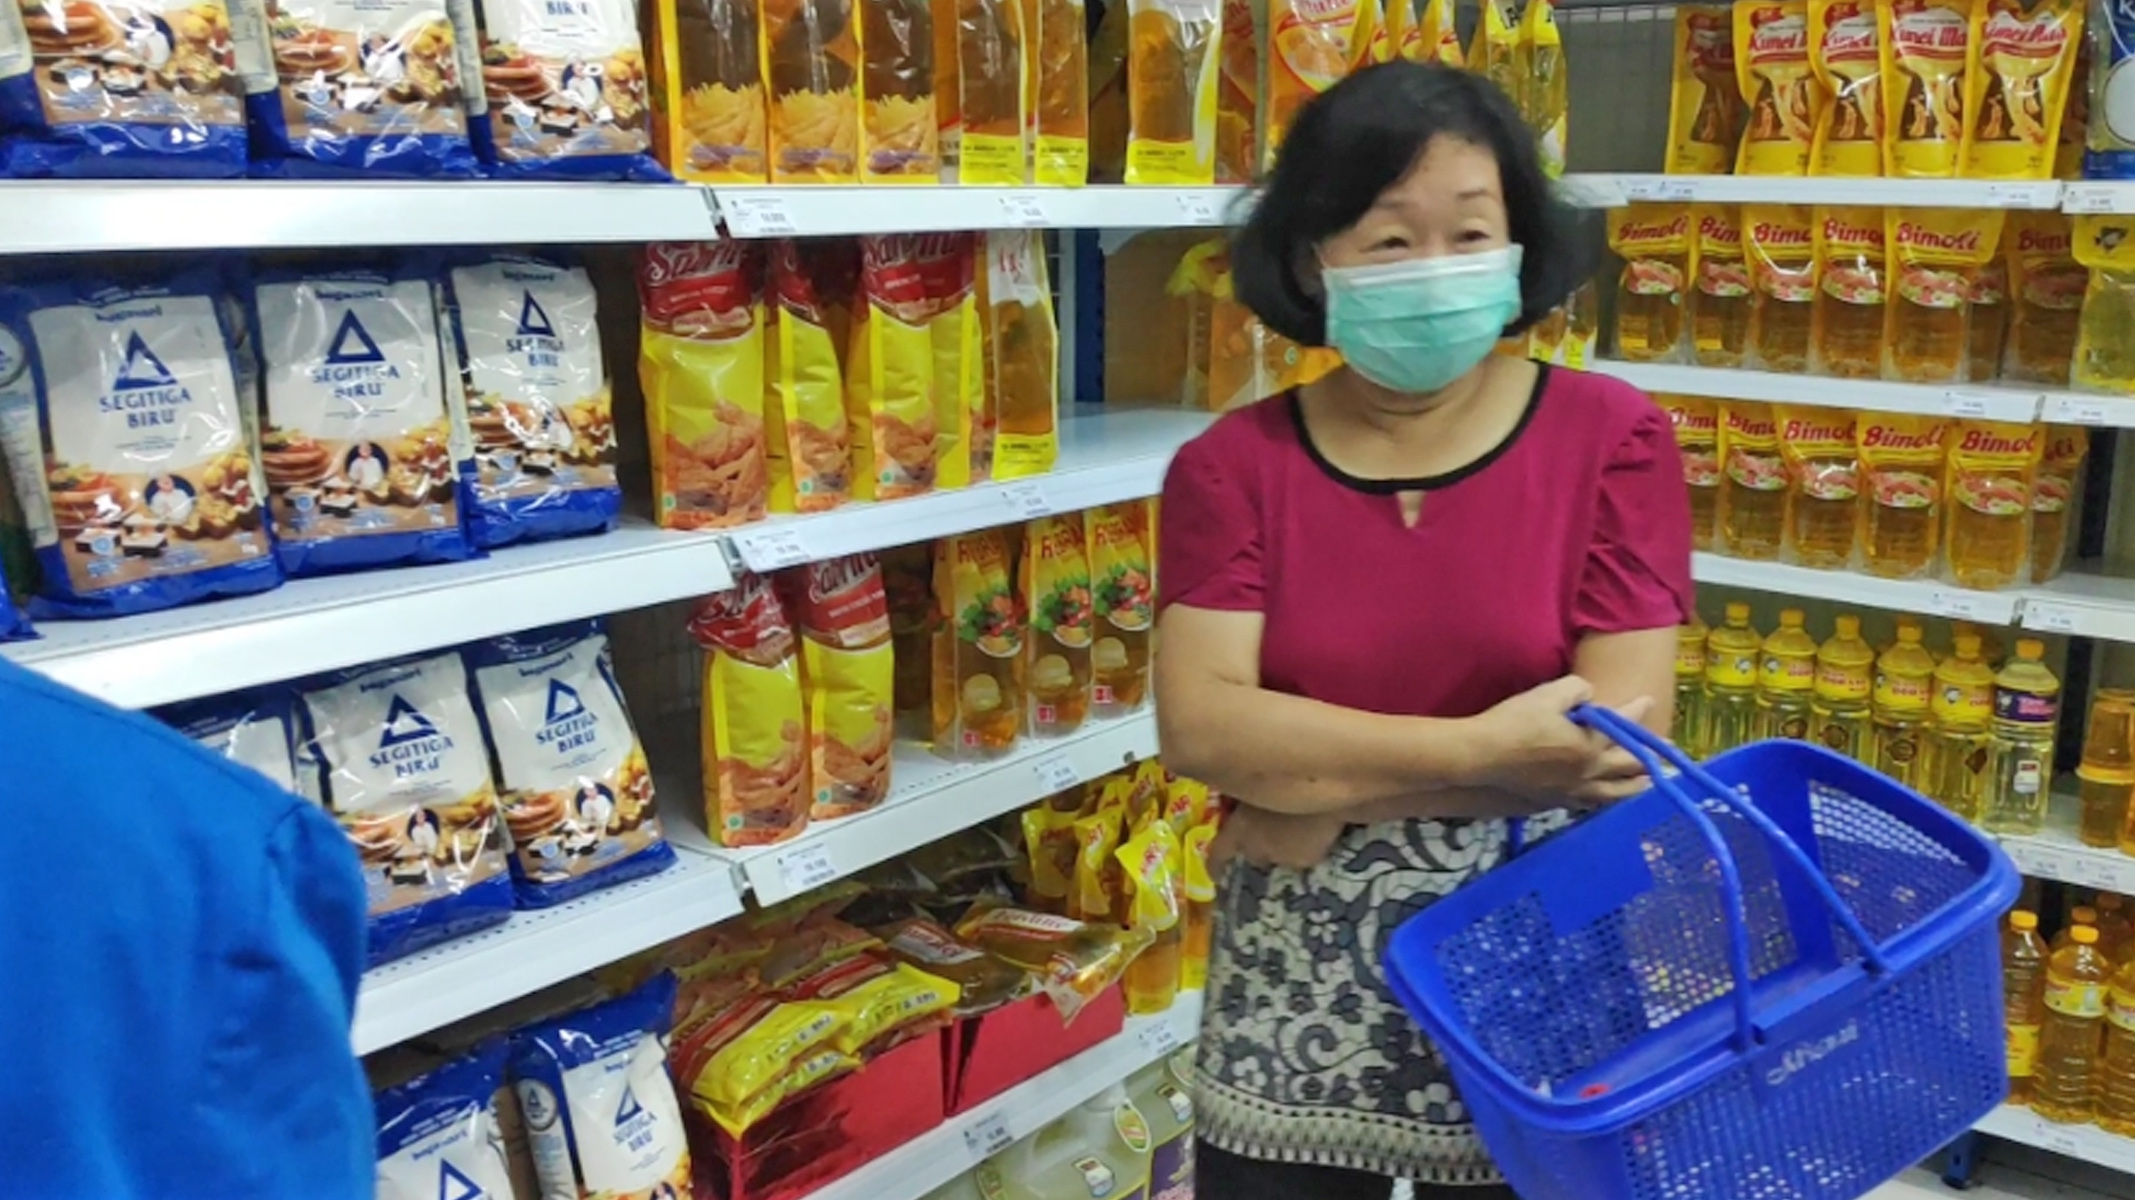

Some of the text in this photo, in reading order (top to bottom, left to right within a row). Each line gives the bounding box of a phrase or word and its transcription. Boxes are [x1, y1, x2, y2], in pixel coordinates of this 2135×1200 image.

[1619, 214, 1690, 241] Bimoli
[1897, 222, 1980, 251] Bimoli
[100, 387, 192, 413] SEGITIGA
[128, 411, 176, 428] BIRU
[1862, 424, 1947, 449] Bimoli
[535, 711, 599, 746] SEGITIGA
[369, 736, 455, 769] SEGITIGA
[557, 731, 596, 753] BIRU
[394, 756, 441, 778] BIRU
